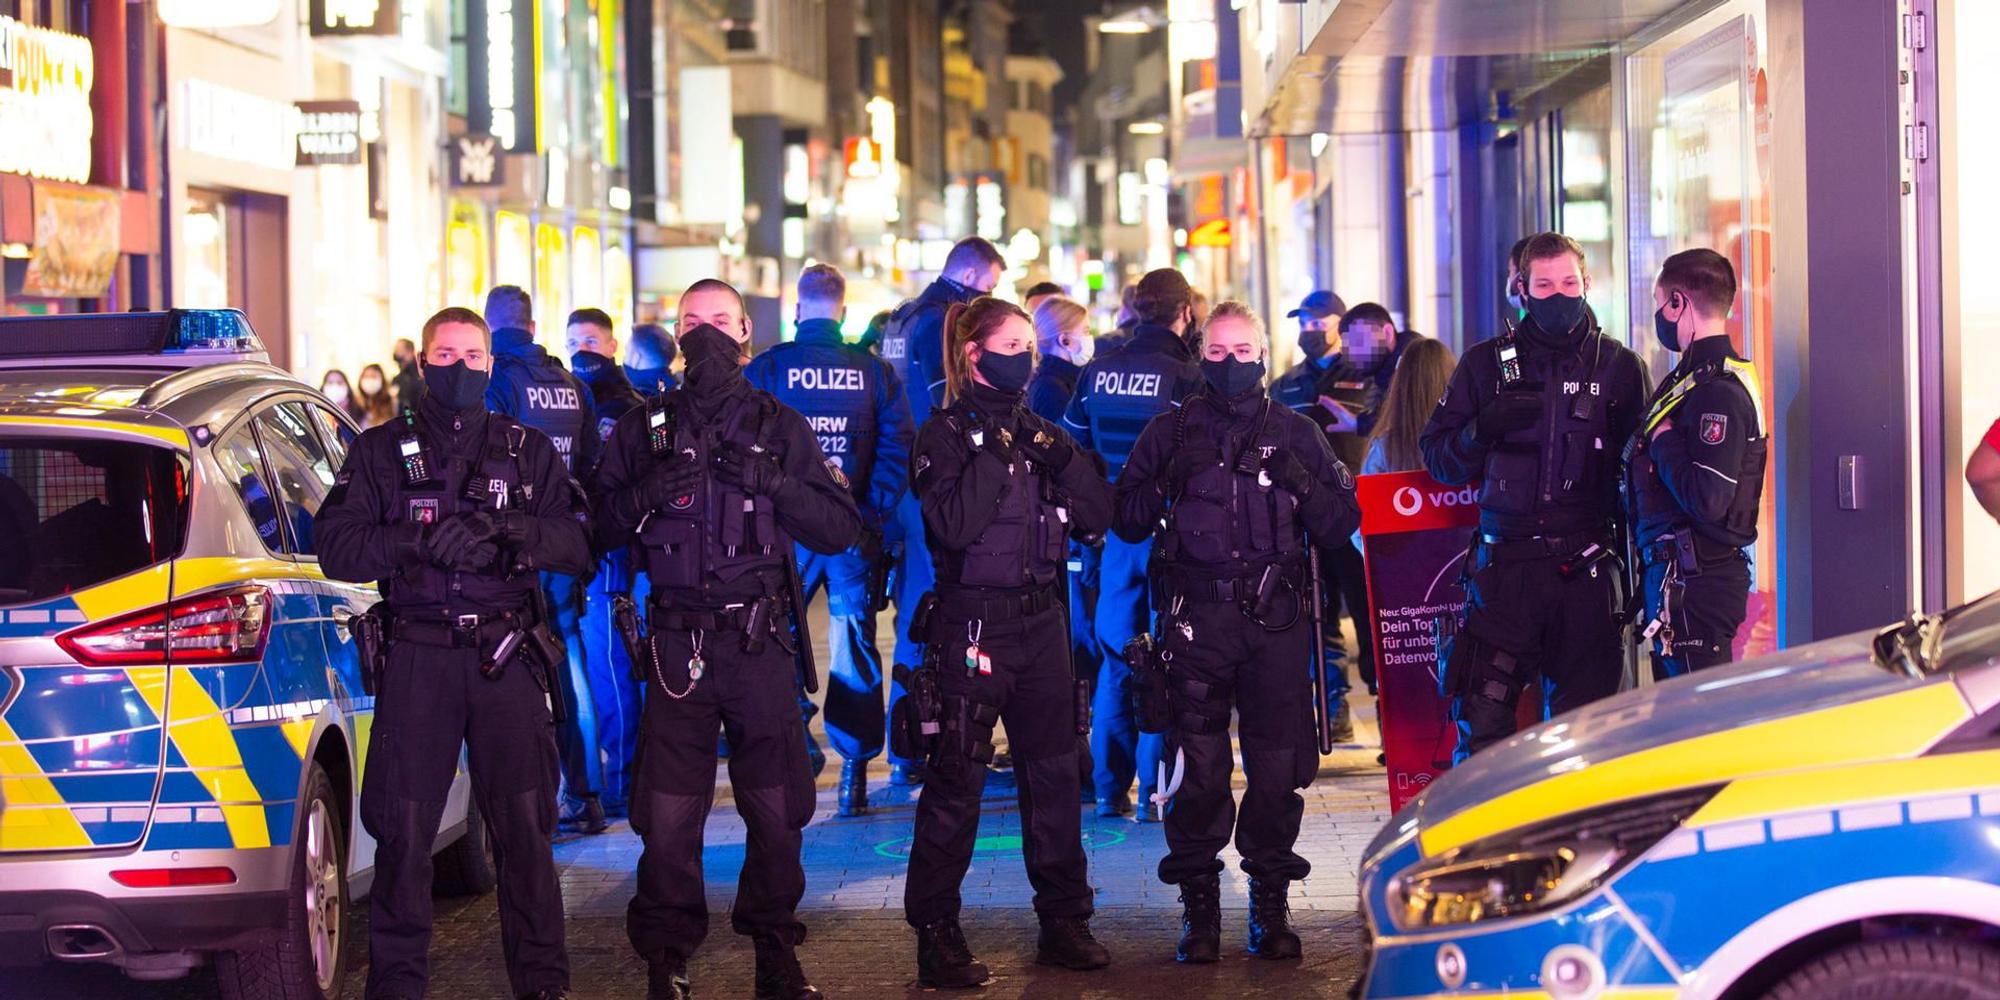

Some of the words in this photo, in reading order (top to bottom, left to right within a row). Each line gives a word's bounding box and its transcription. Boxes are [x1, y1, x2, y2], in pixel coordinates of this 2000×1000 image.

[790, 367, 865, 390] POLIZEI
[1094, 371, 1161, 397] POLIZEI
[526, 387, 580, 410] POLIZEI
[551, 436, 573, 453] RW
[817, 436, 848, 453] 212
[489, 479, 503, 493] ZEI
[1381, 620, 1410, 634] Dein
[1382, 636, 1401, 649] für
